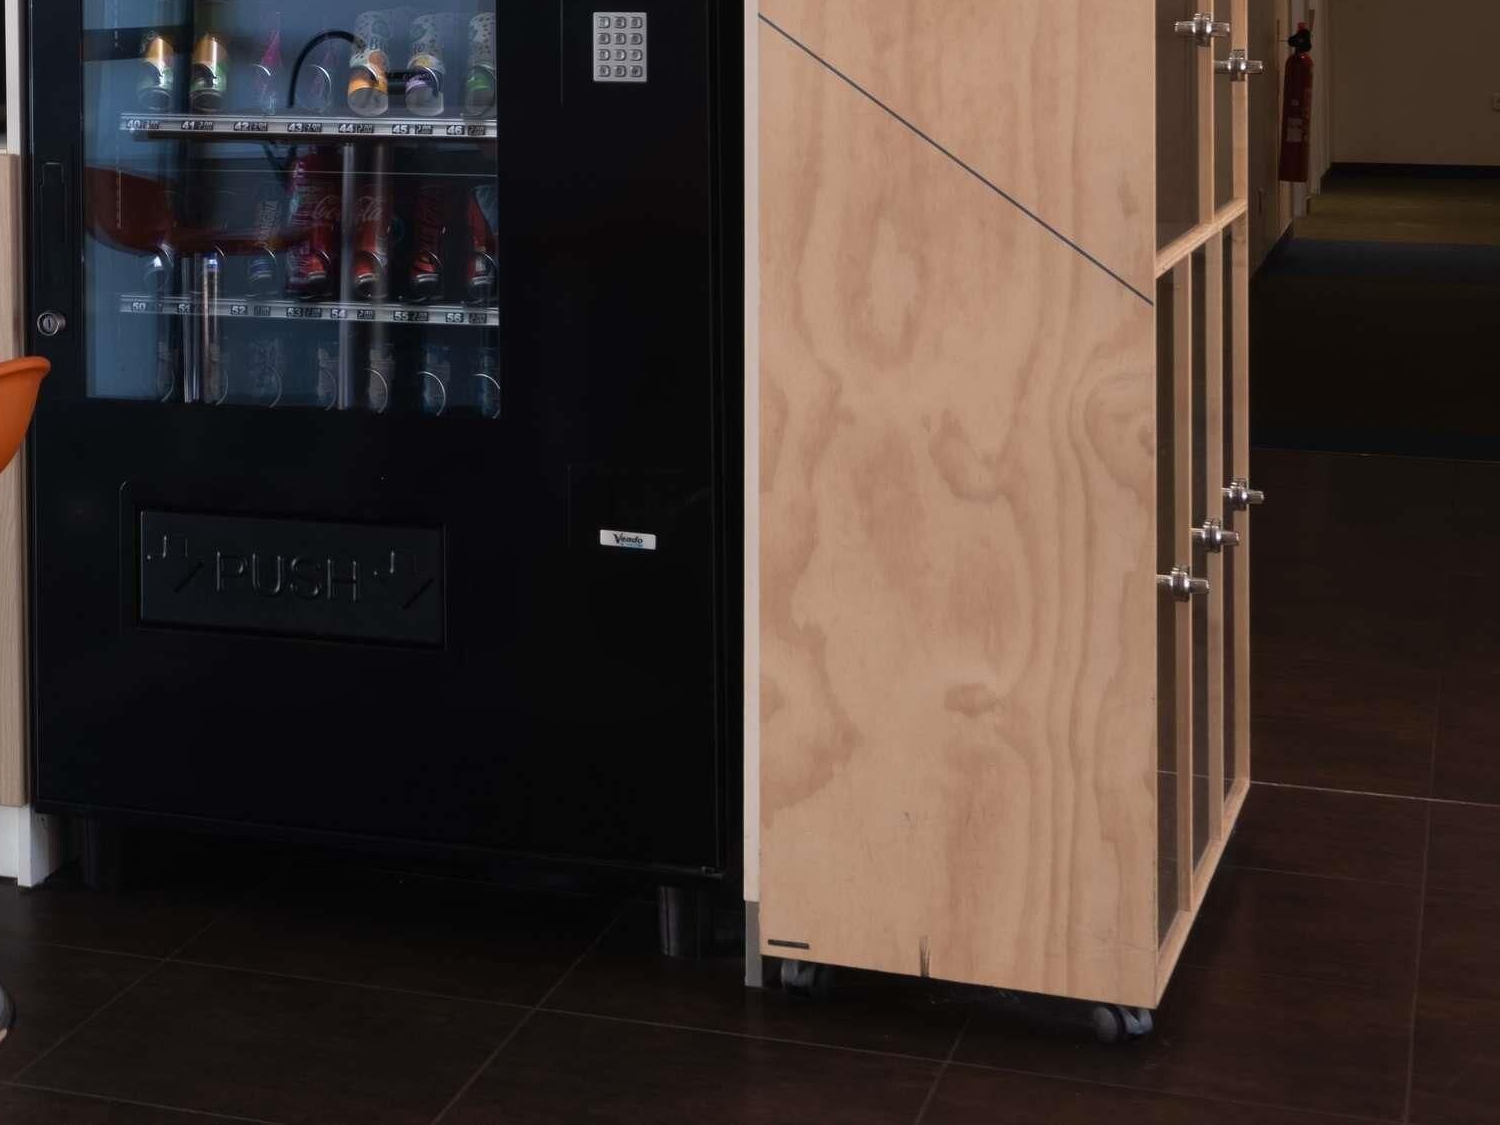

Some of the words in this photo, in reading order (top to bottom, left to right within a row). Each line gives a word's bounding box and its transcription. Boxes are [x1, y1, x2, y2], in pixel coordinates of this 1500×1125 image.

[181, 121, 195, 130] 41
[233, 122, 249, 131] 42
[287, 123, 302, 132] 43
[339, 124, 354, 133] 44
[392, 125, 408, 134] 45
[446, 125, 464, 135] 46
[231, 306, 246, 315] 52
[286, 307, 300, 316] 53
[331, 309, 346, 318] 54
[394, 311, 409, 321] 55
[446, 312, 462, 322] 56
[216, 551, 358, 603] PUSH
